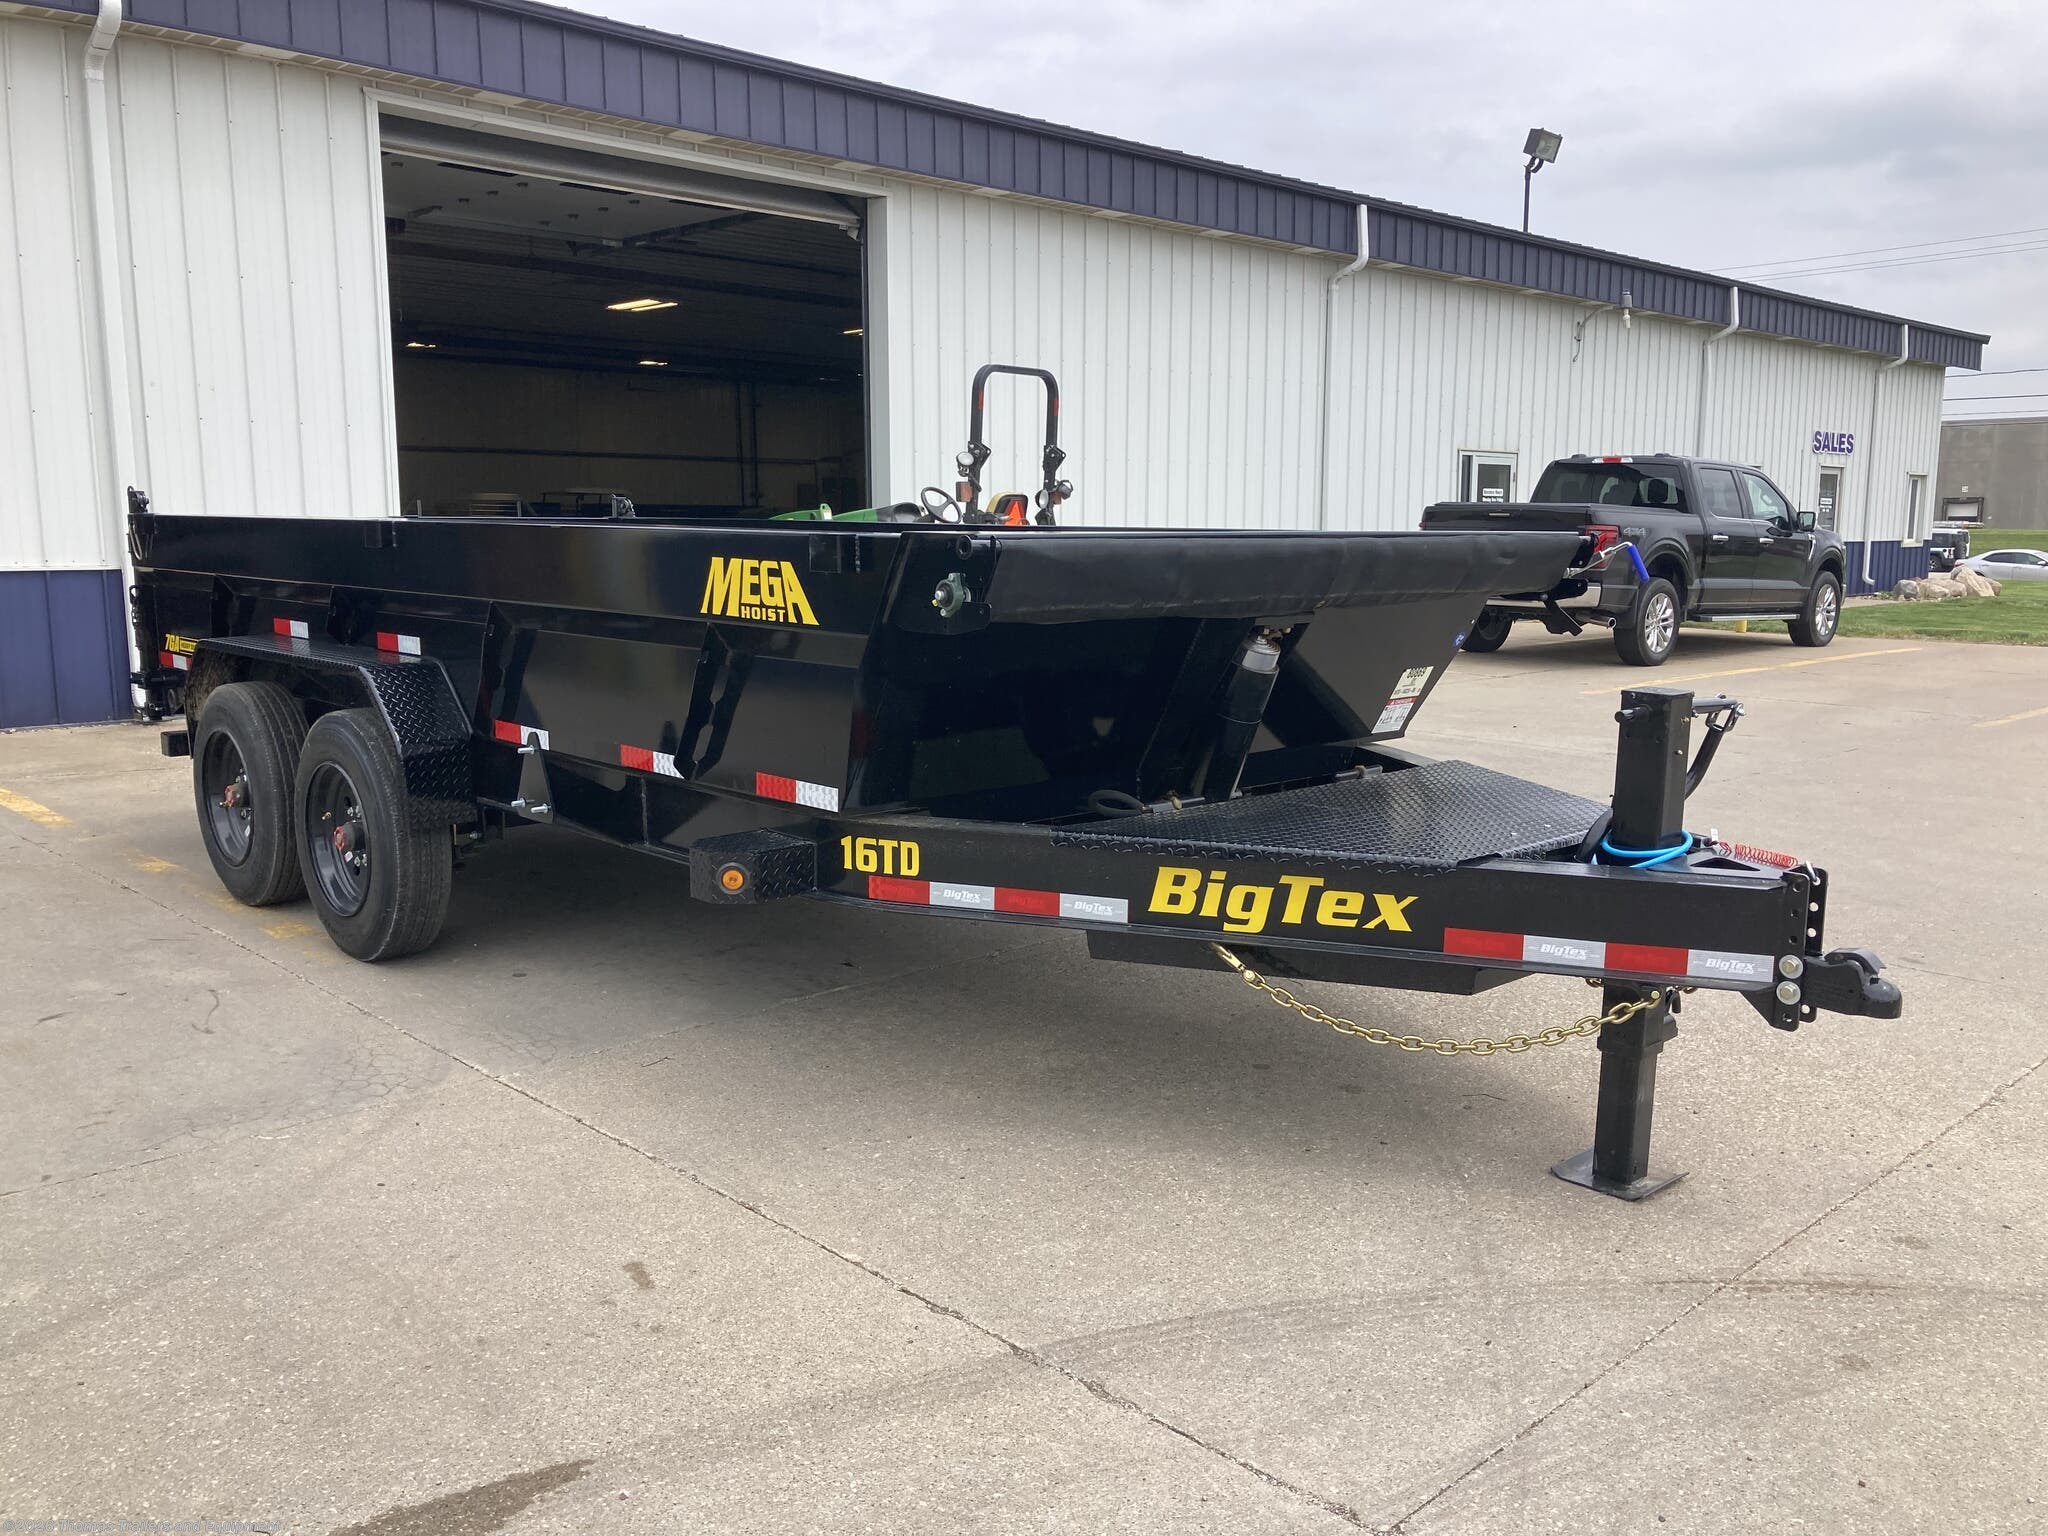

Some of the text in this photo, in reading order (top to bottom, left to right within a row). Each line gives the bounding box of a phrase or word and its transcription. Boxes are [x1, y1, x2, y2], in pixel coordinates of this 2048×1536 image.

[1812, 430, 1855, 454] SALES
[700, 556, 820, 626] MEGA
[740, 605, 786, 623] HOIST
[840, 835, 920, 877] 16TD
[943, 889, 980, 901] BigTex
[1147, 866, 1419, 934] BigTex
[1073, 901, 1113, 913] BigTex
[1540, 943, 1588, 957] BigTex
[1705, 958, 1756, 971] BigTex
